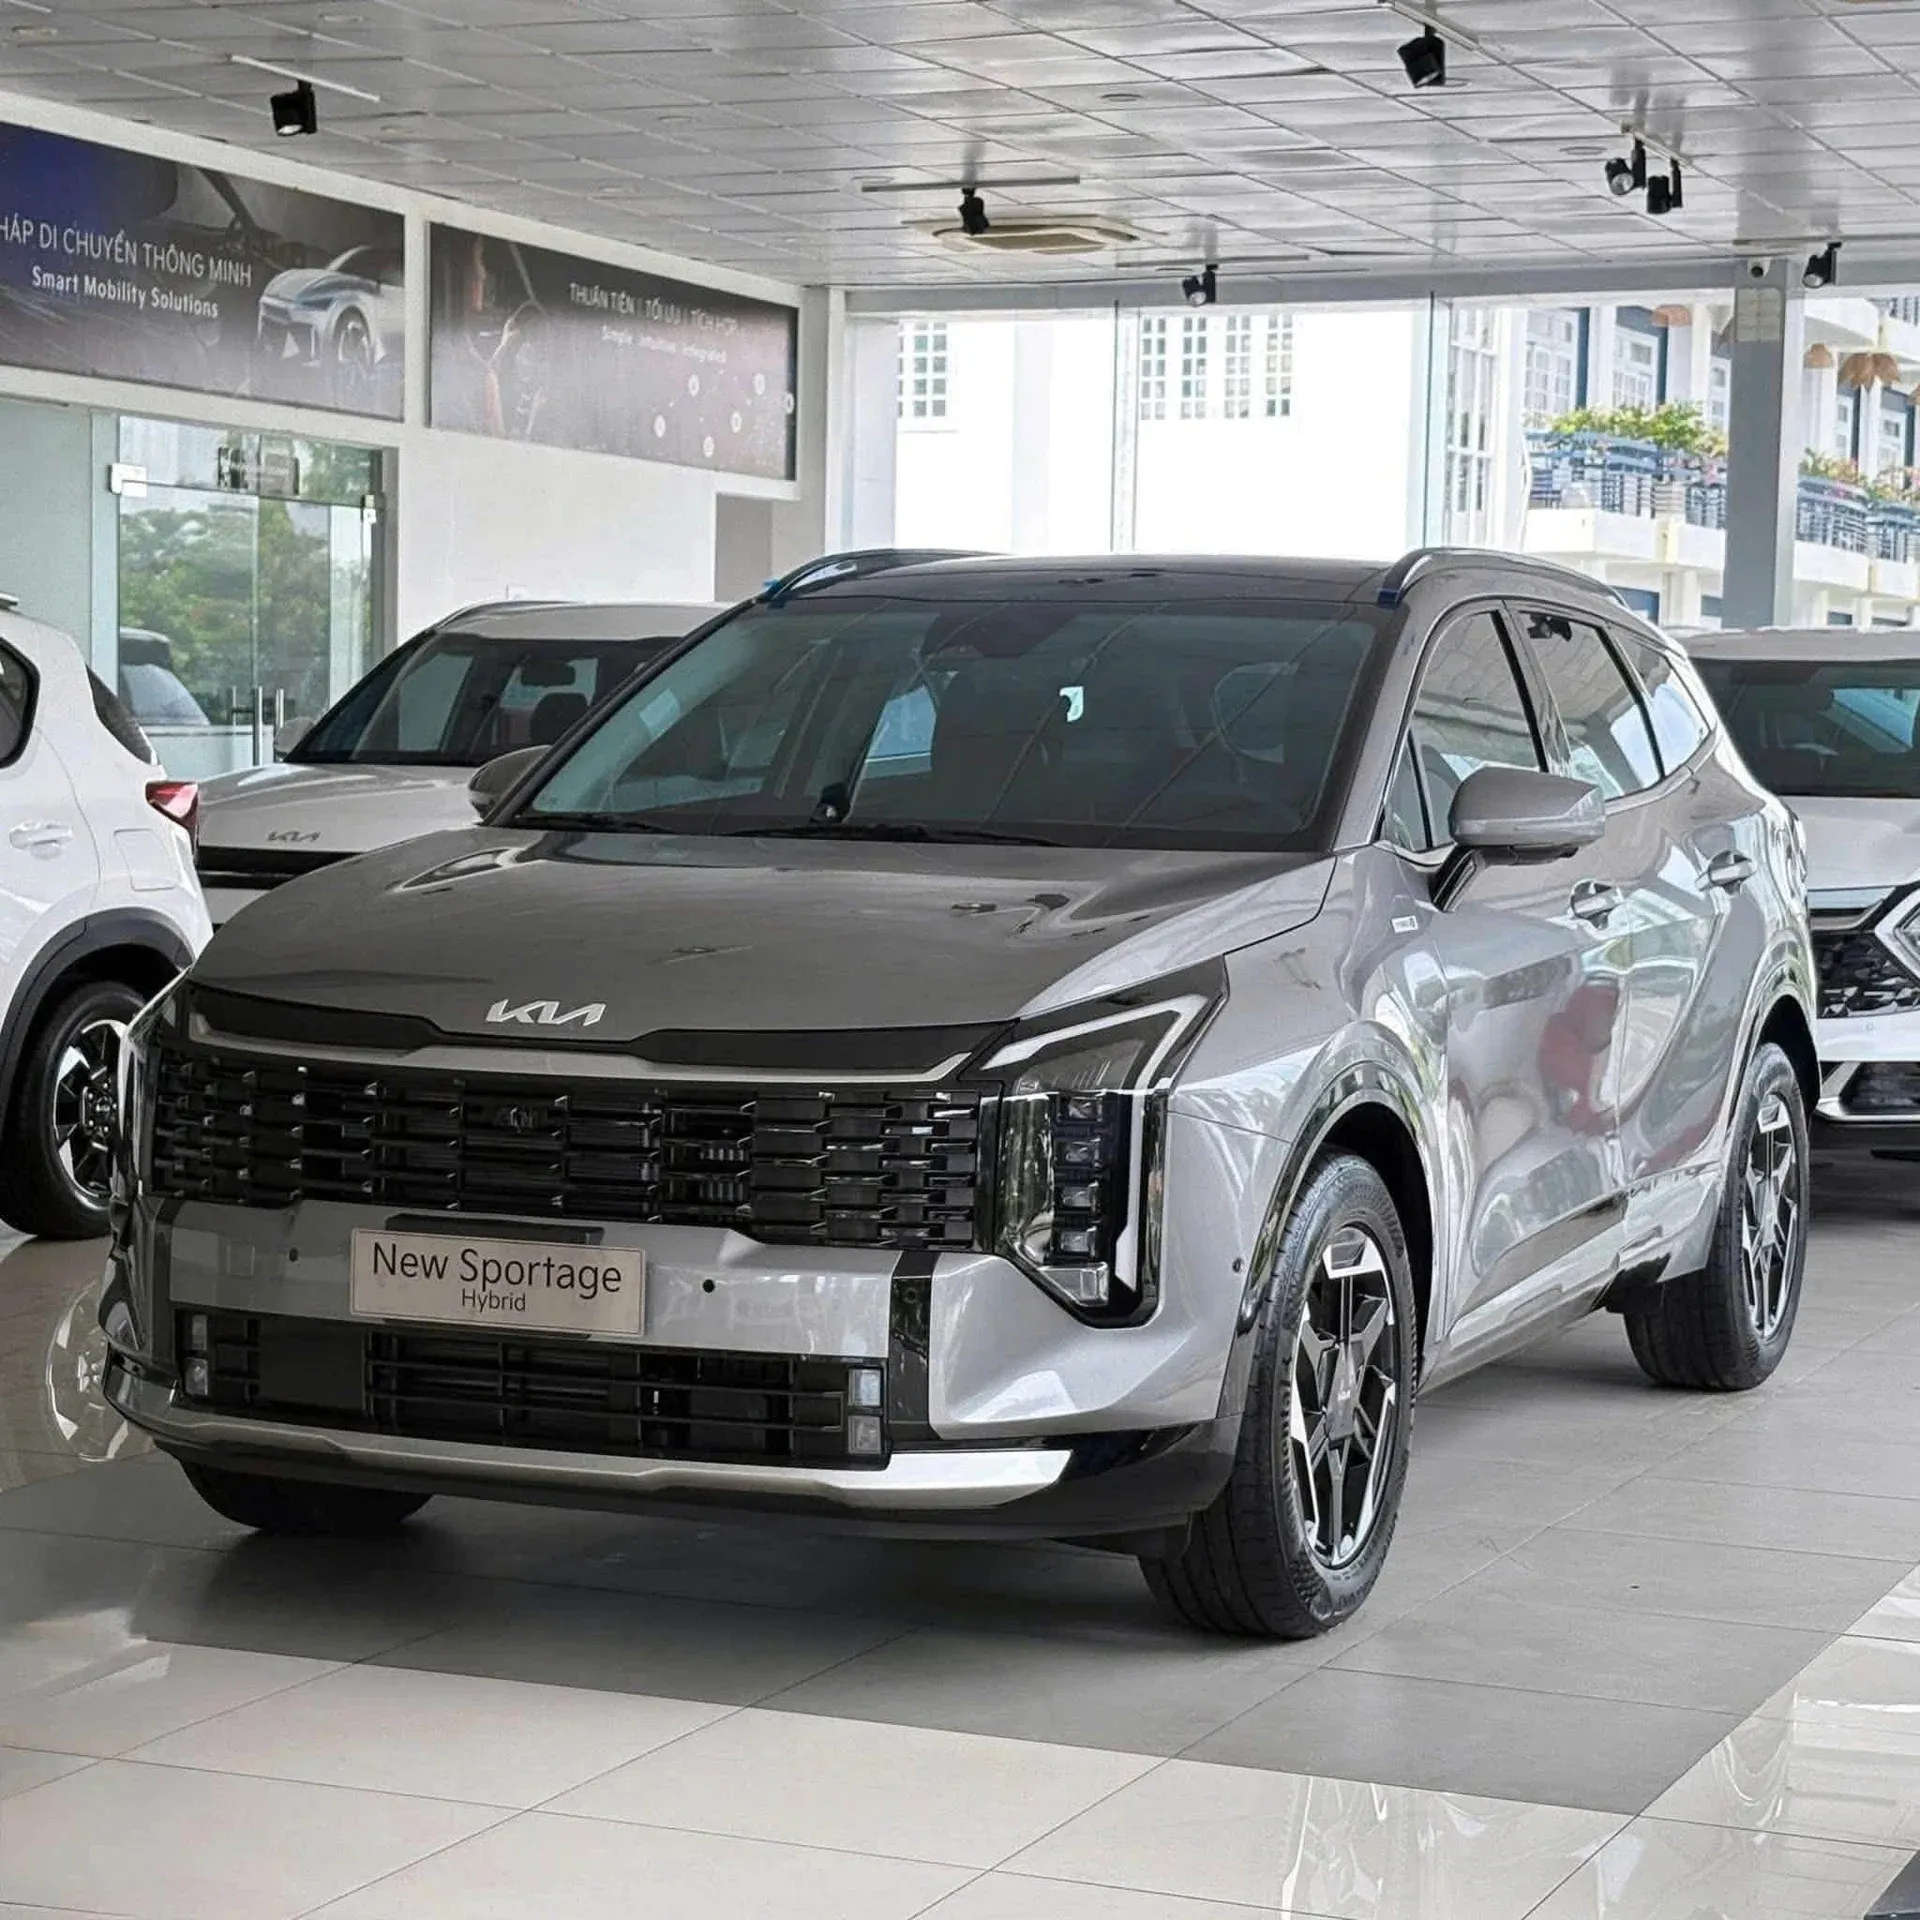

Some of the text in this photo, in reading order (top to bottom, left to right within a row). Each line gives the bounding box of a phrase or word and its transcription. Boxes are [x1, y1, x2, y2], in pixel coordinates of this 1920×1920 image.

[39, 222, 58, 251] DI
[63, 227, 138, 266] CHUYỂN
[142, 243, 205, 278] THÔNG
[208, 255, 253, 288] MINH
[32, 265, 219, 319] Smart Mobility Solutions
[485, 999, 606, 1027] KIA
[373, 1242, 622, 1300] New Sportage
[461, 1288, 527, 1314] Hybrid
